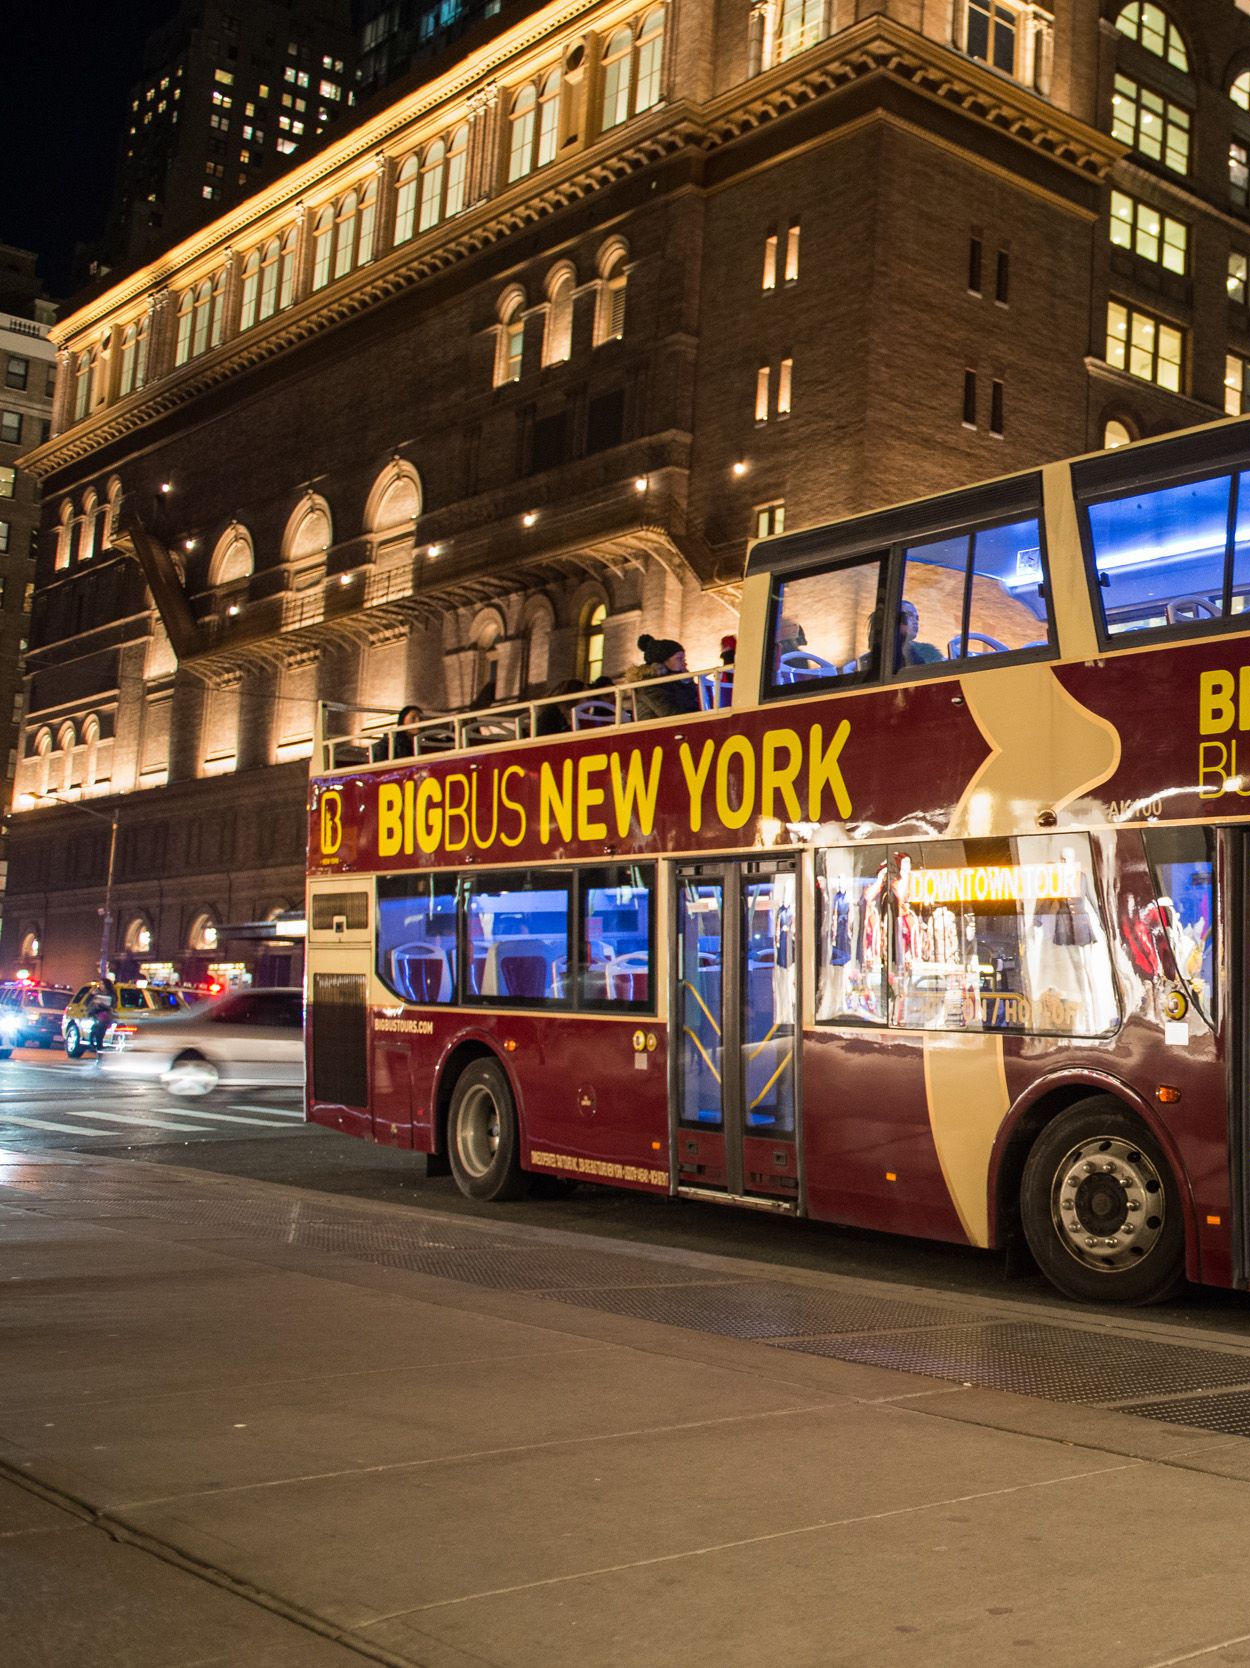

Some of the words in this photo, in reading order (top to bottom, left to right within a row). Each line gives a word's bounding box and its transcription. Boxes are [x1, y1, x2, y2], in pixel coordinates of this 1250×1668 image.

[539, 746, 663, 844] NEW
[678, 719, 853, 832] YORK
[911, 866, 1021, 902] DOWNTOWN
[1022, 864, 1078, 898] TOUR
[374, 1018, 434, 1035] BIGBUSTOURS.COM
